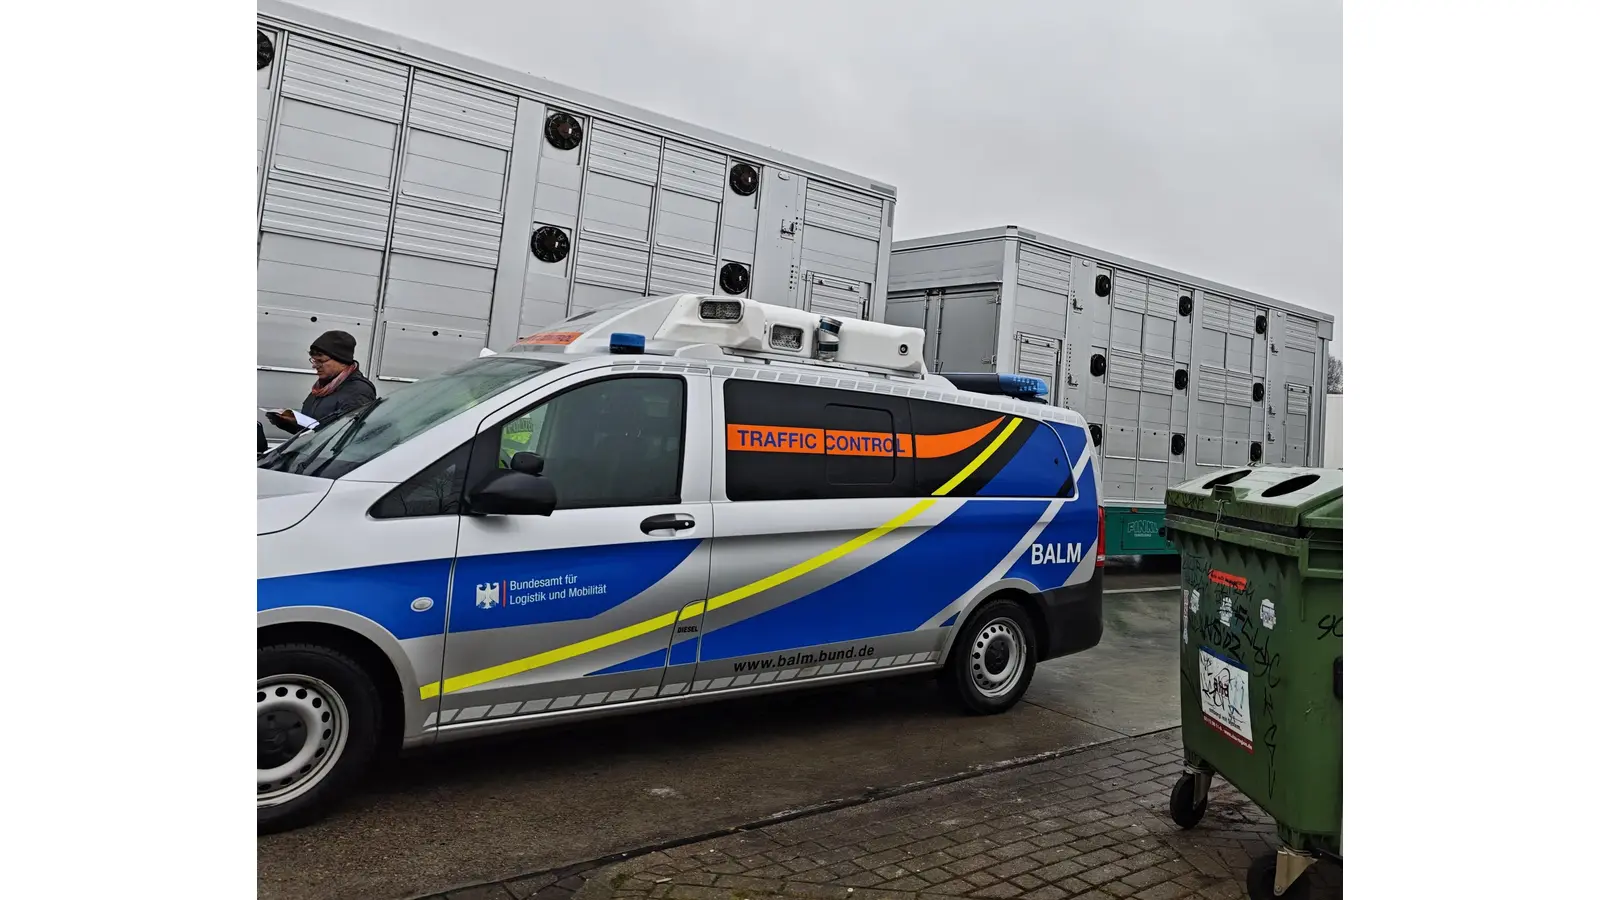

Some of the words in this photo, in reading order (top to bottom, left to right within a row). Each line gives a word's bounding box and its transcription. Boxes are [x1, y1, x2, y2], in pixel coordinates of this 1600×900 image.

[737, 429, 817, 450] TRAFFIC
[826, 434, 906, 454] CONTROL
[1031, 542, 1082, 565] BALM
[509, 575, 563, 591] Bundesamt
[564, 573, 578, 585] für
[509, 592, 547, 606] Logistik
[548, 588, 567, 601] und
[568, 583, 607, 598] Mobilität
[677, 625, 699, 634] DIESEL
[733, 644, 875, 673] www.balm.bund.de
